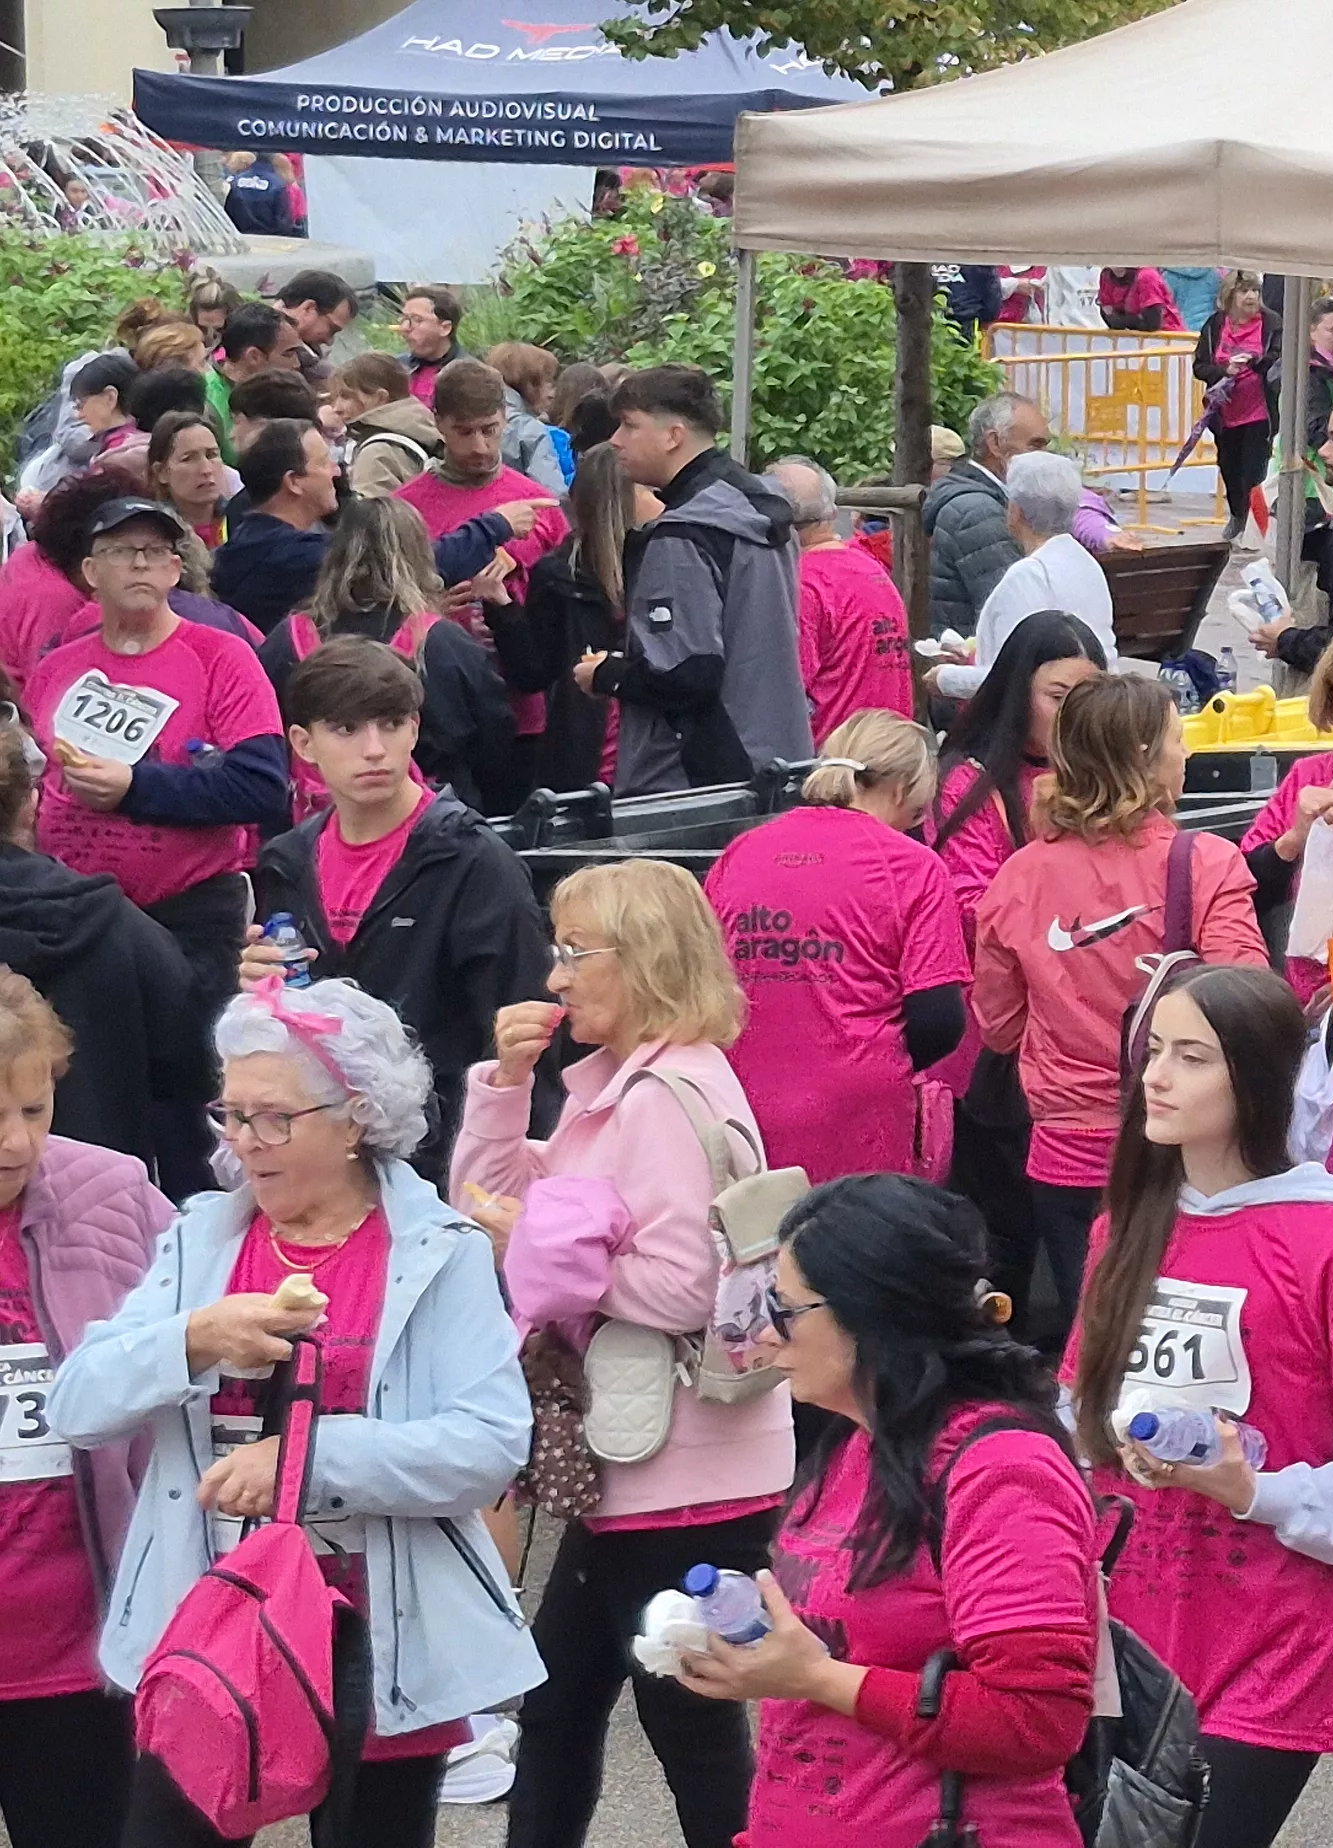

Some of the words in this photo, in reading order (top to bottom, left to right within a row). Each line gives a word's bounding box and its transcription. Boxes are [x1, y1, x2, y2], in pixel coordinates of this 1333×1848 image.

[402, 36, 500, 59] HAD
[296, 94, 444, 117] PRODUCCIÓN
[449, 100, 600, 122] AUDIOVISUAL
[236, 118, 408, 143] COMUNICACIÓN
[414, 126, 429, 143] &
[436, 126, 566, 149] MARKETING
[573, 130, 664, 152] DIGITAL
[72, 694, 151, 742] 1206
[736, 902, 793, 934] alto
